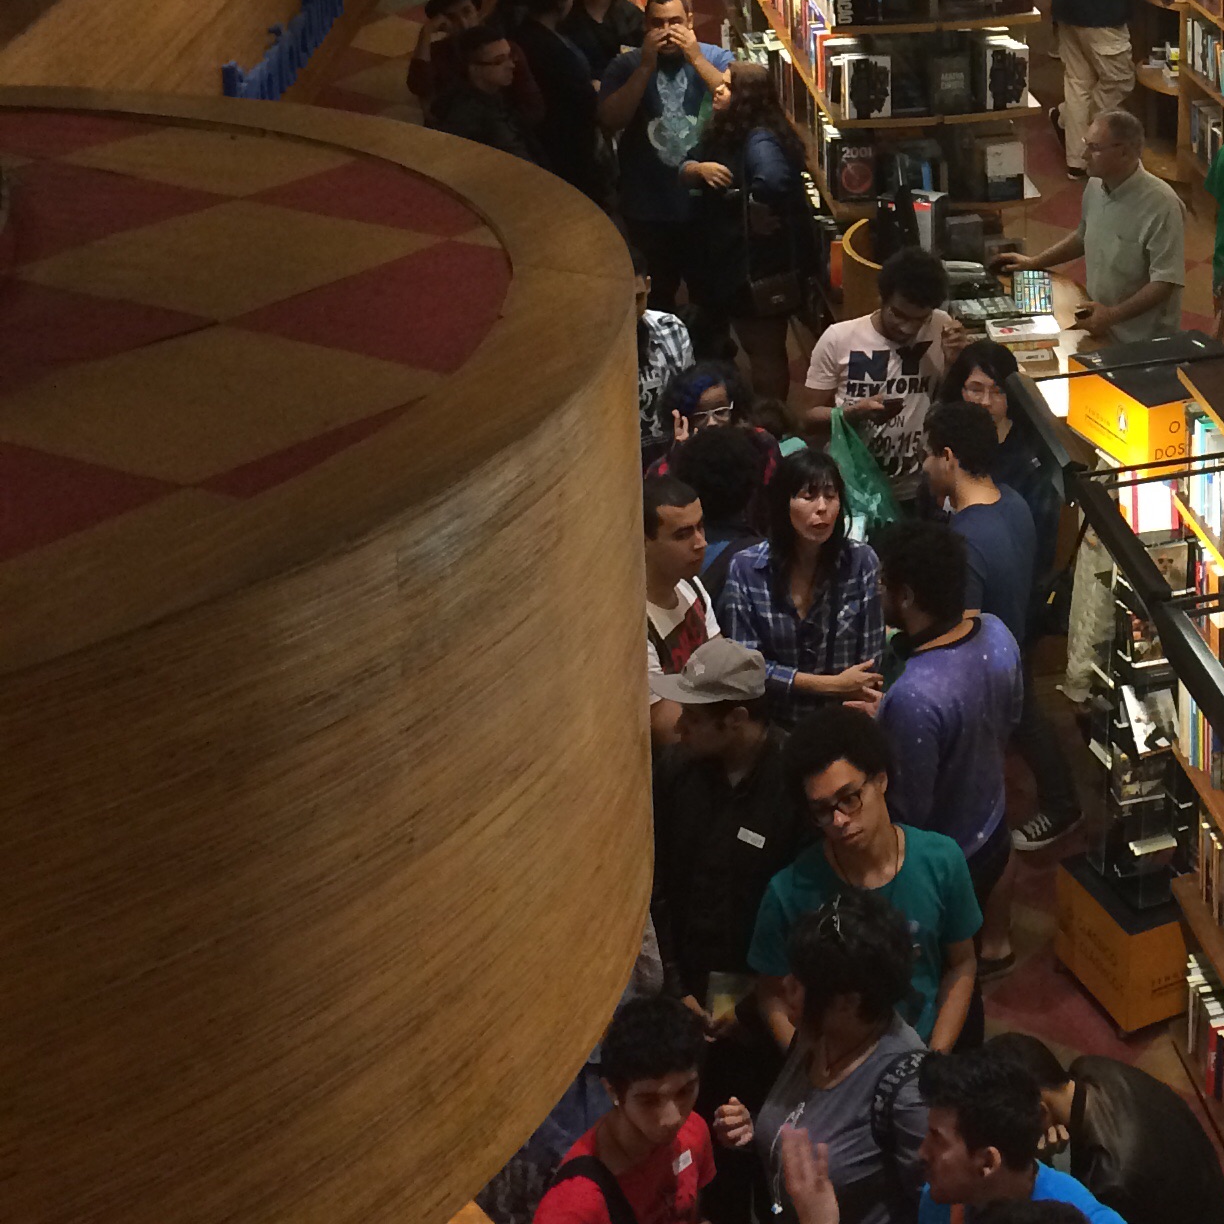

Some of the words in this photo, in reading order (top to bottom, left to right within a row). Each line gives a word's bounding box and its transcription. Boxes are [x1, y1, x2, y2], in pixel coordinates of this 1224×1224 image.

[841, 146, 873, 159] 2001
[846, 380, 882, 398] NEW
[886, 376, 929, 395] YORK
[1154, 442, 1185, 461] DOS
